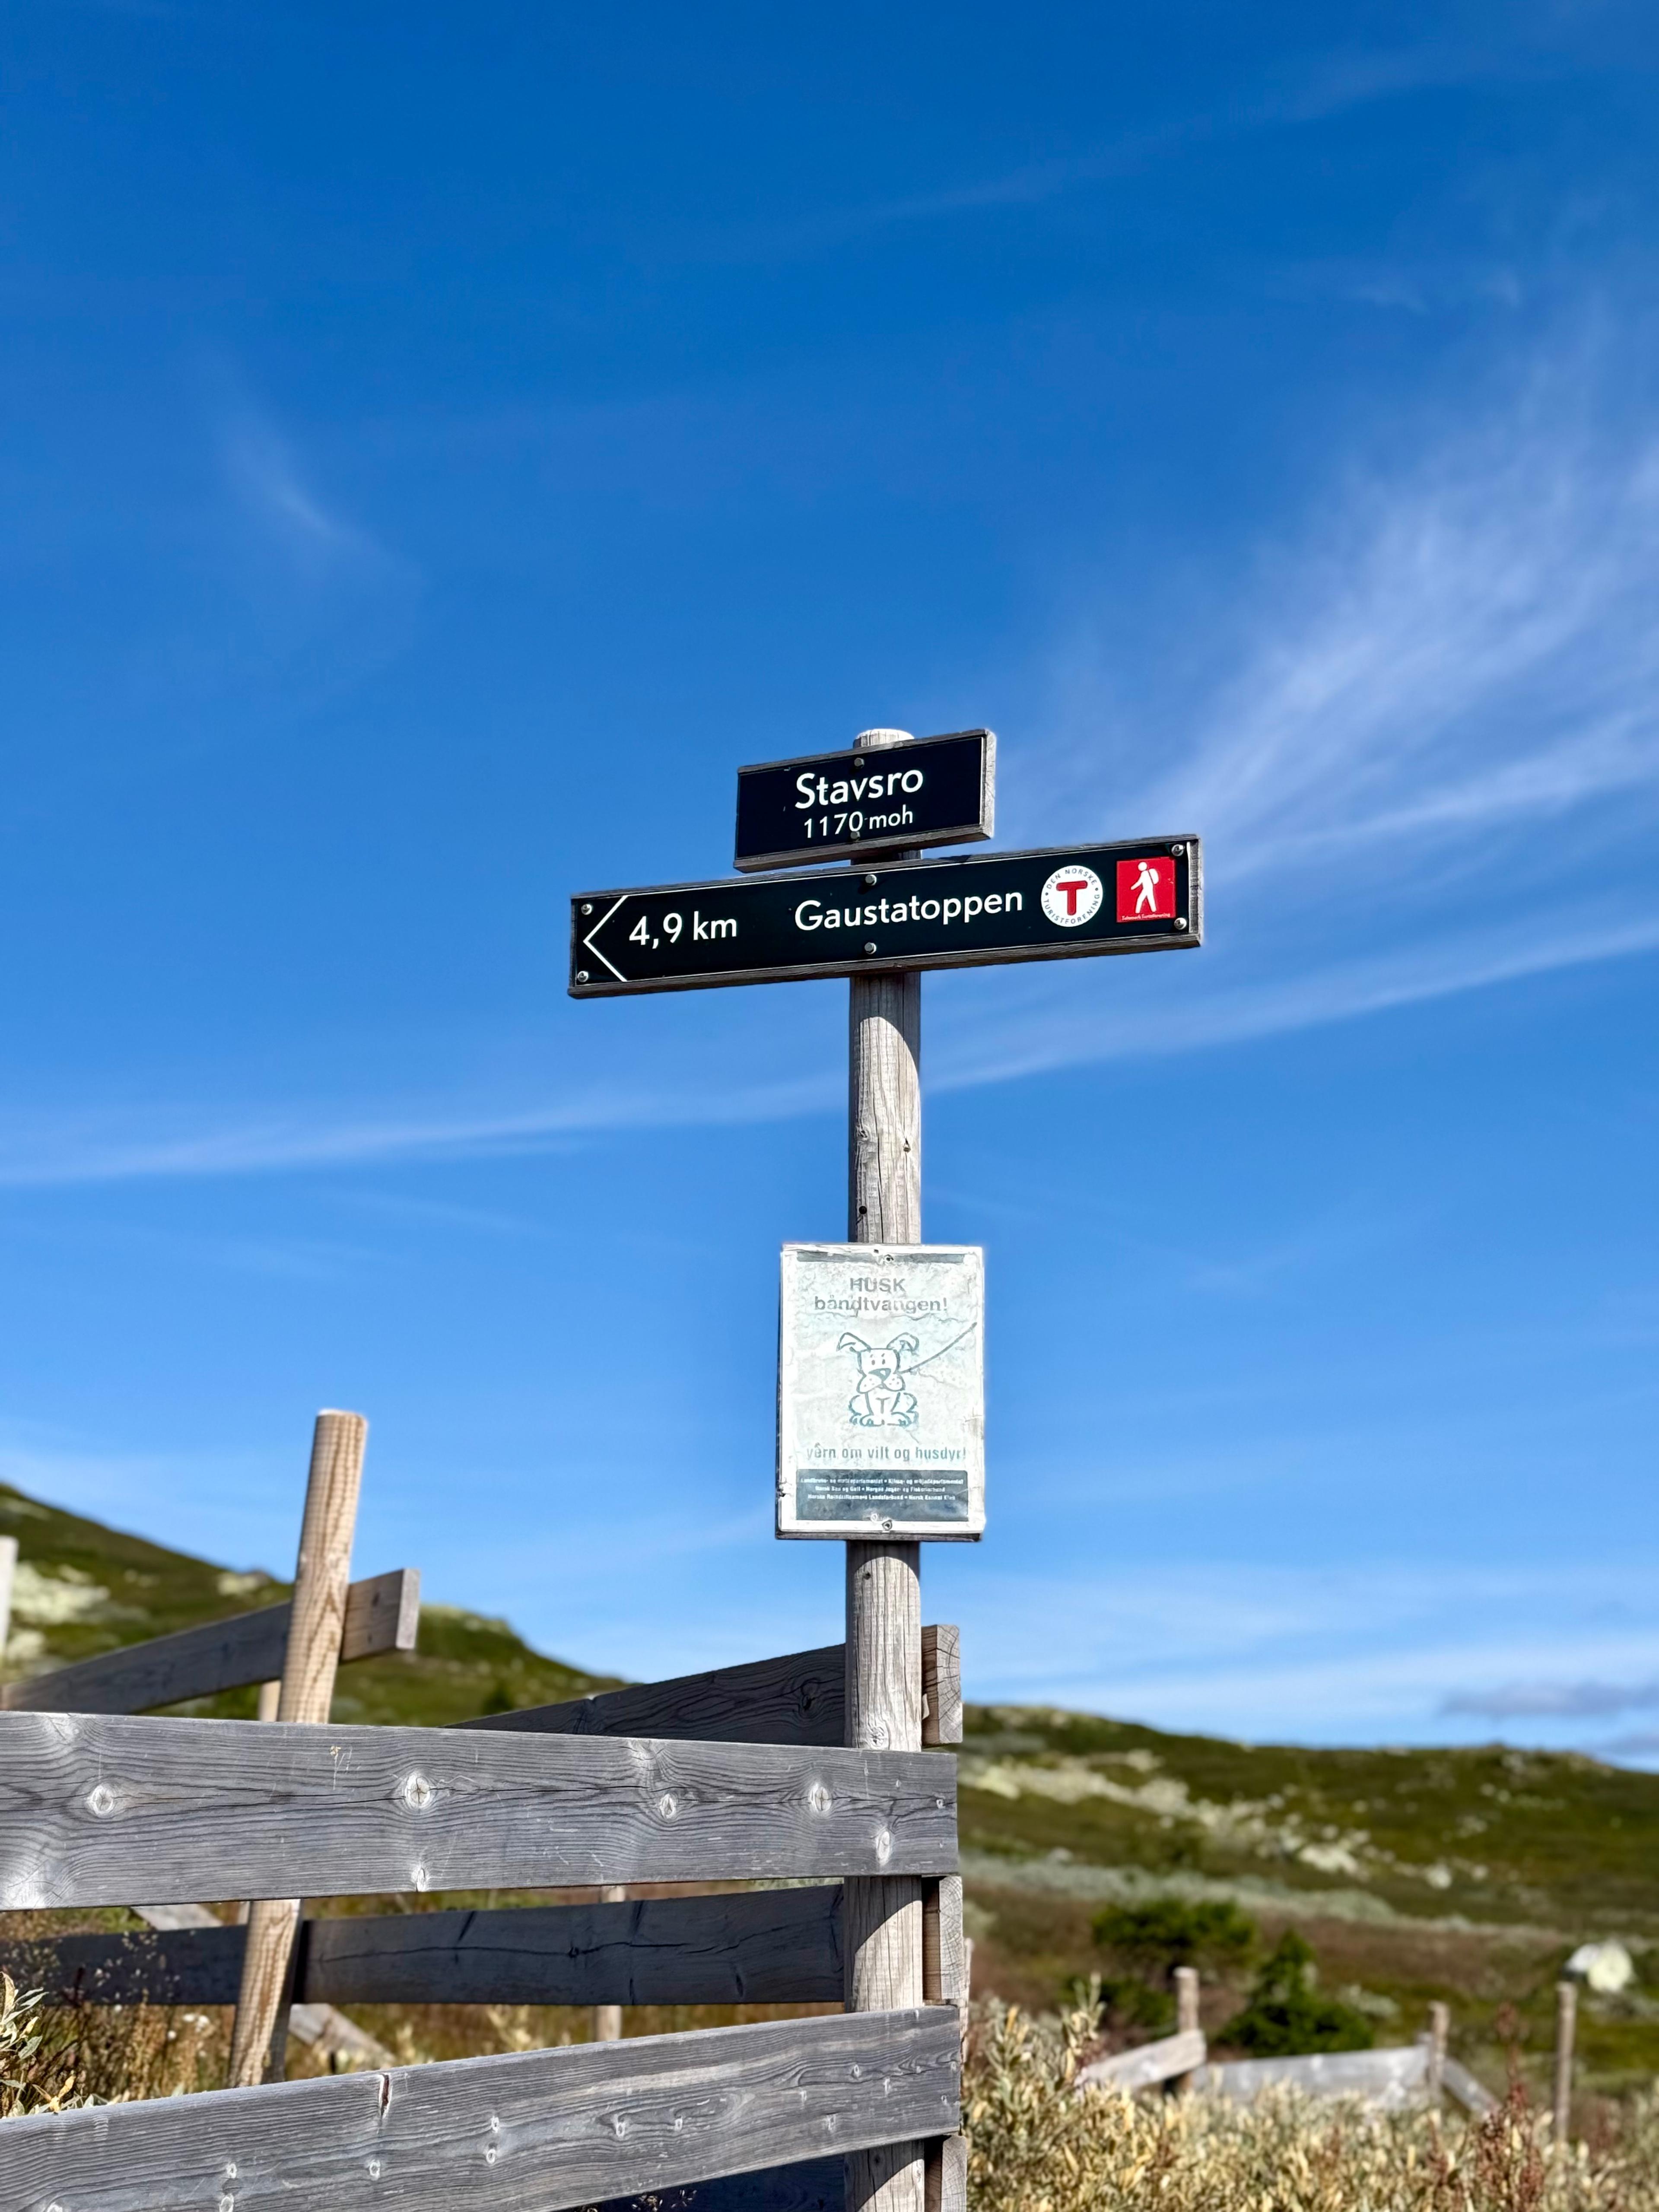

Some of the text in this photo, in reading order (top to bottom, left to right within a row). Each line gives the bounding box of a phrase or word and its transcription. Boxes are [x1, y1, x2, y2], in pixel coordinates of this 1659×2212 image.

[795, 769, 923, 809] Stavsro
[804, 804, 913, 838] 1170 moh
[1046, 868, 1097, 890] DEN NORSKE
[795, 892, 1022, 931] Gaustatoppen
[1043, 894, 1100, 924] TURISTFORENING
[1056, 880, 1088, 915] T
[629, 911, 737, 949] 4,9 km
[850, 1277, 906, 1293] HUSK
[814, 1295, 947, 1314] båndtvangen!
[842, 1448, 862, 1459] om
[867, 1446, 889, 1459] vilt
[894, 1448, 910, 1462] og
[915, 1446, 966, 1462] husdyr!
